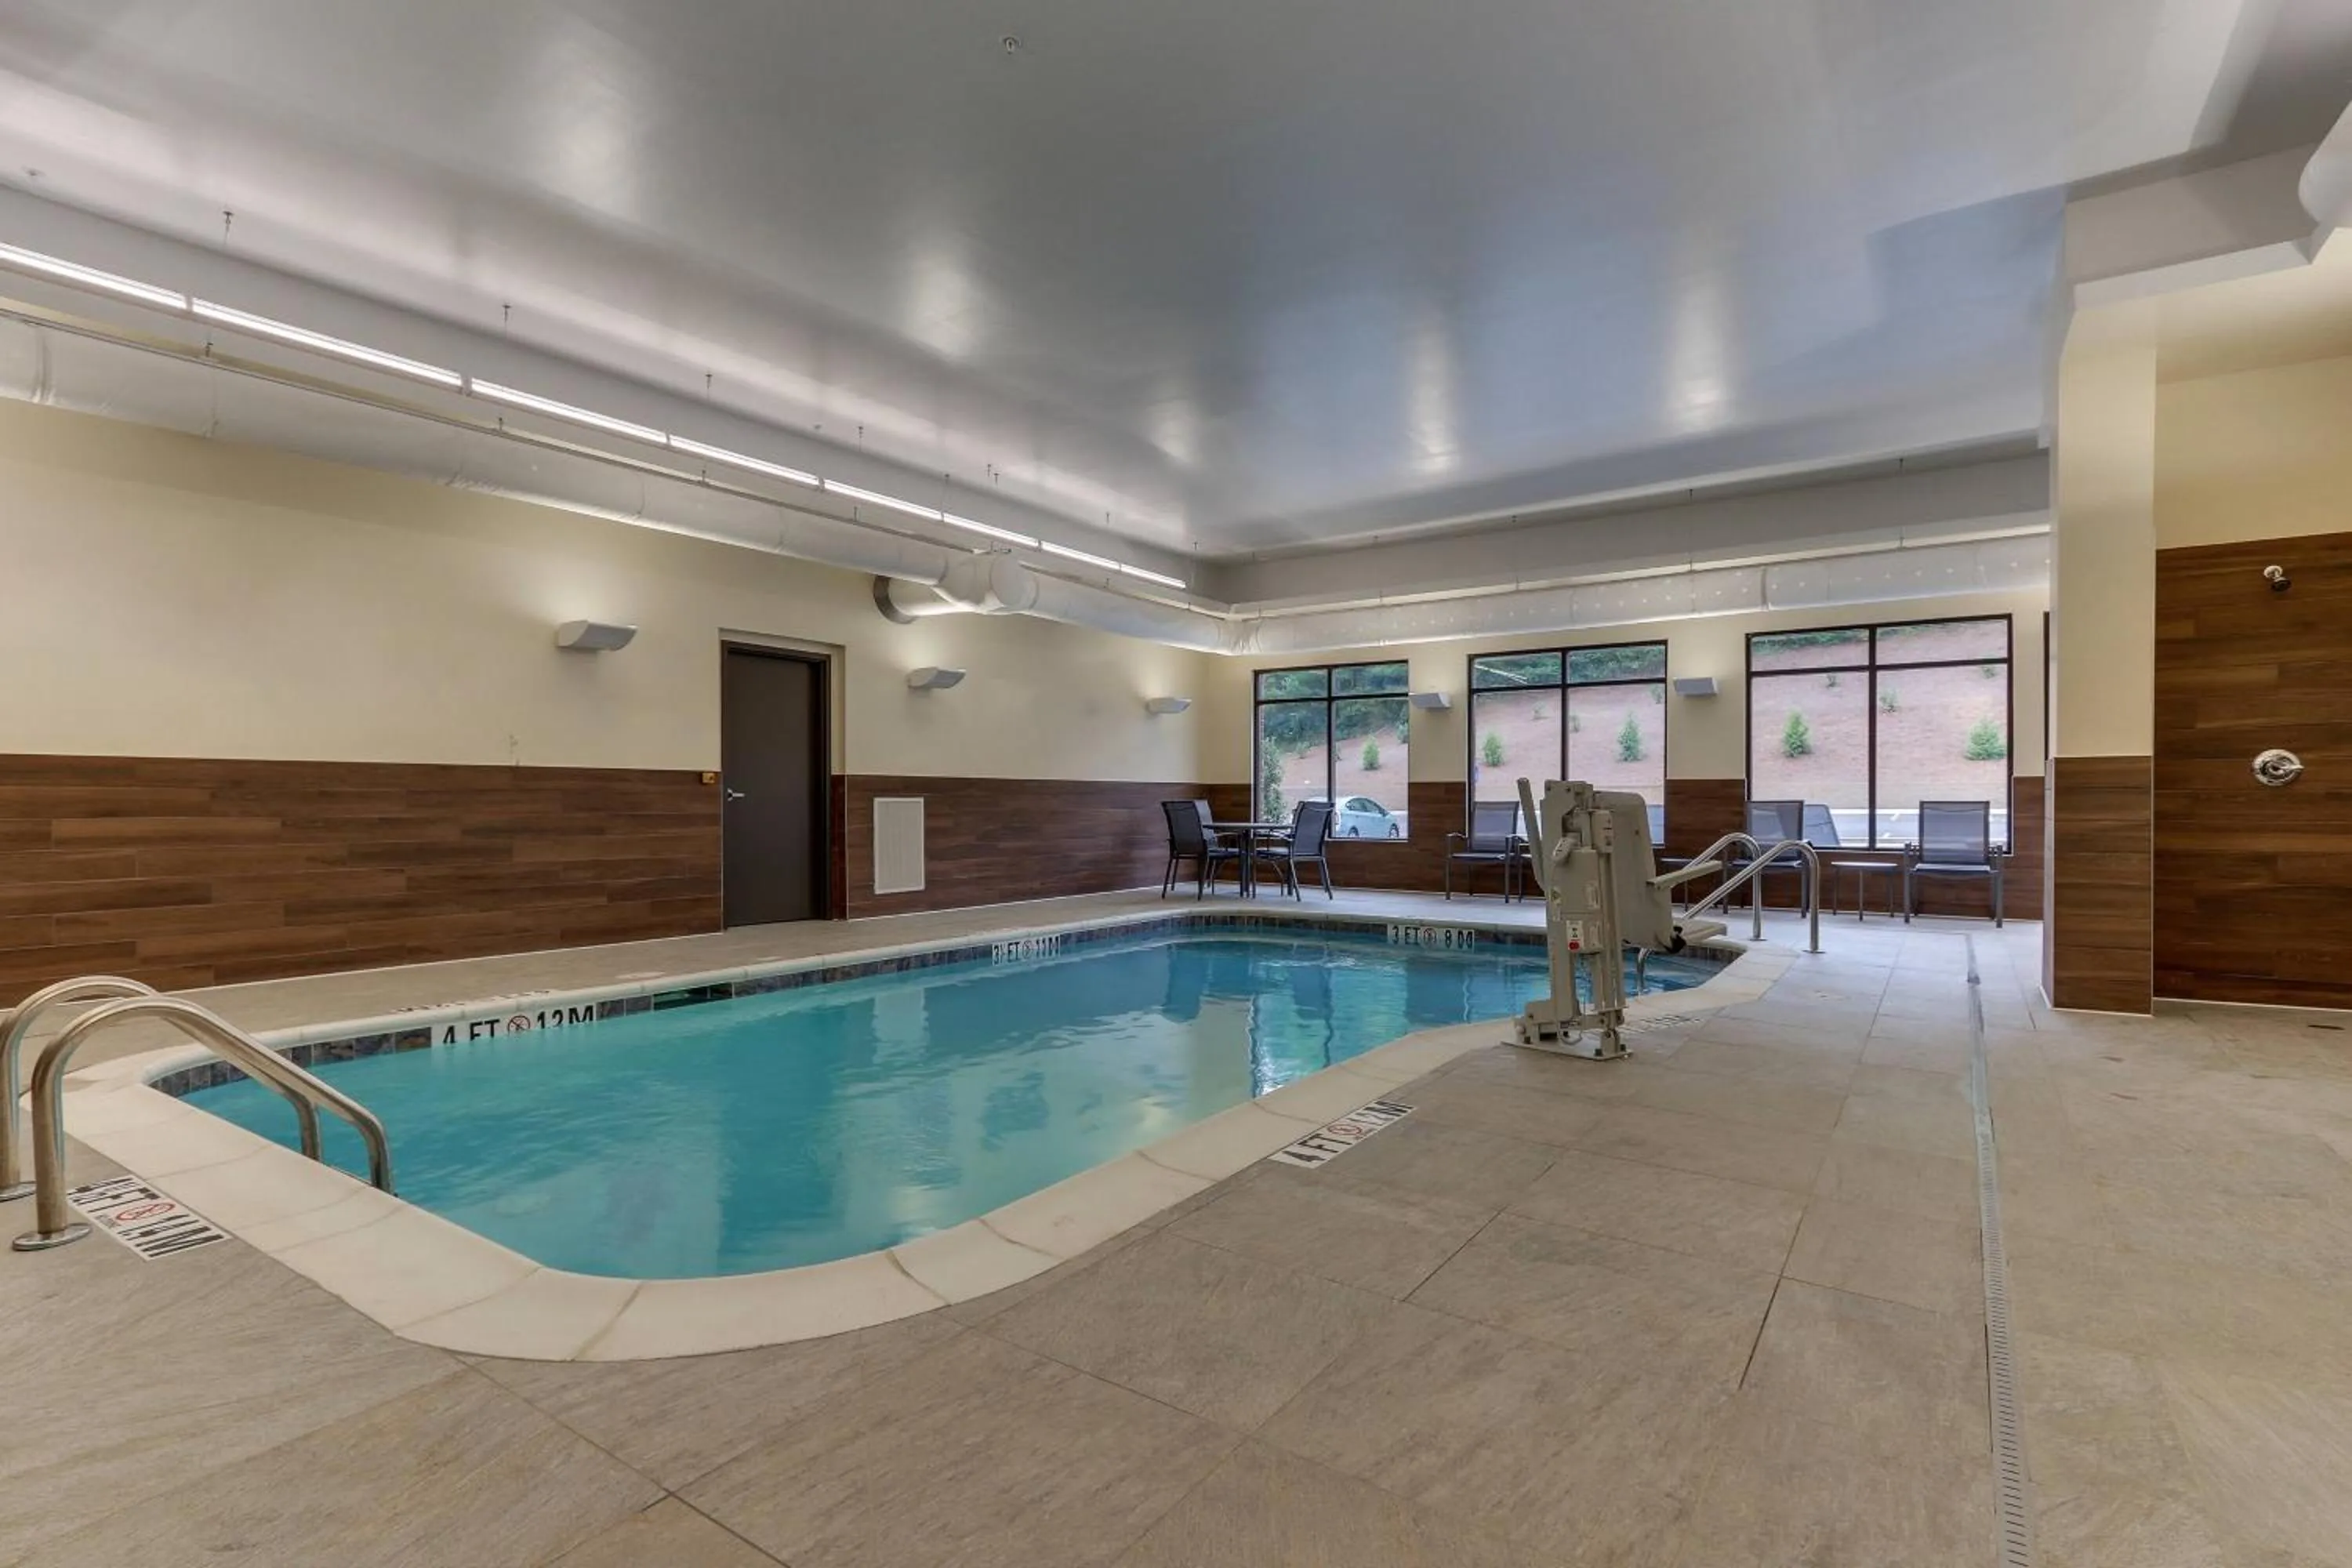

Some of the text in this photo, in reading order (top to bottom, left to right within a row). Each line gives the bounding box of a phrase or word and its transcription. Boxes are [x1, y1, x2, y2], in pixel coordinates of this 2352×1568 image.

[470, 1019, 500, 1041] FT
[1298, 1134, 1352, 1153] FT
[78, 1187, 160, 1213] FT
